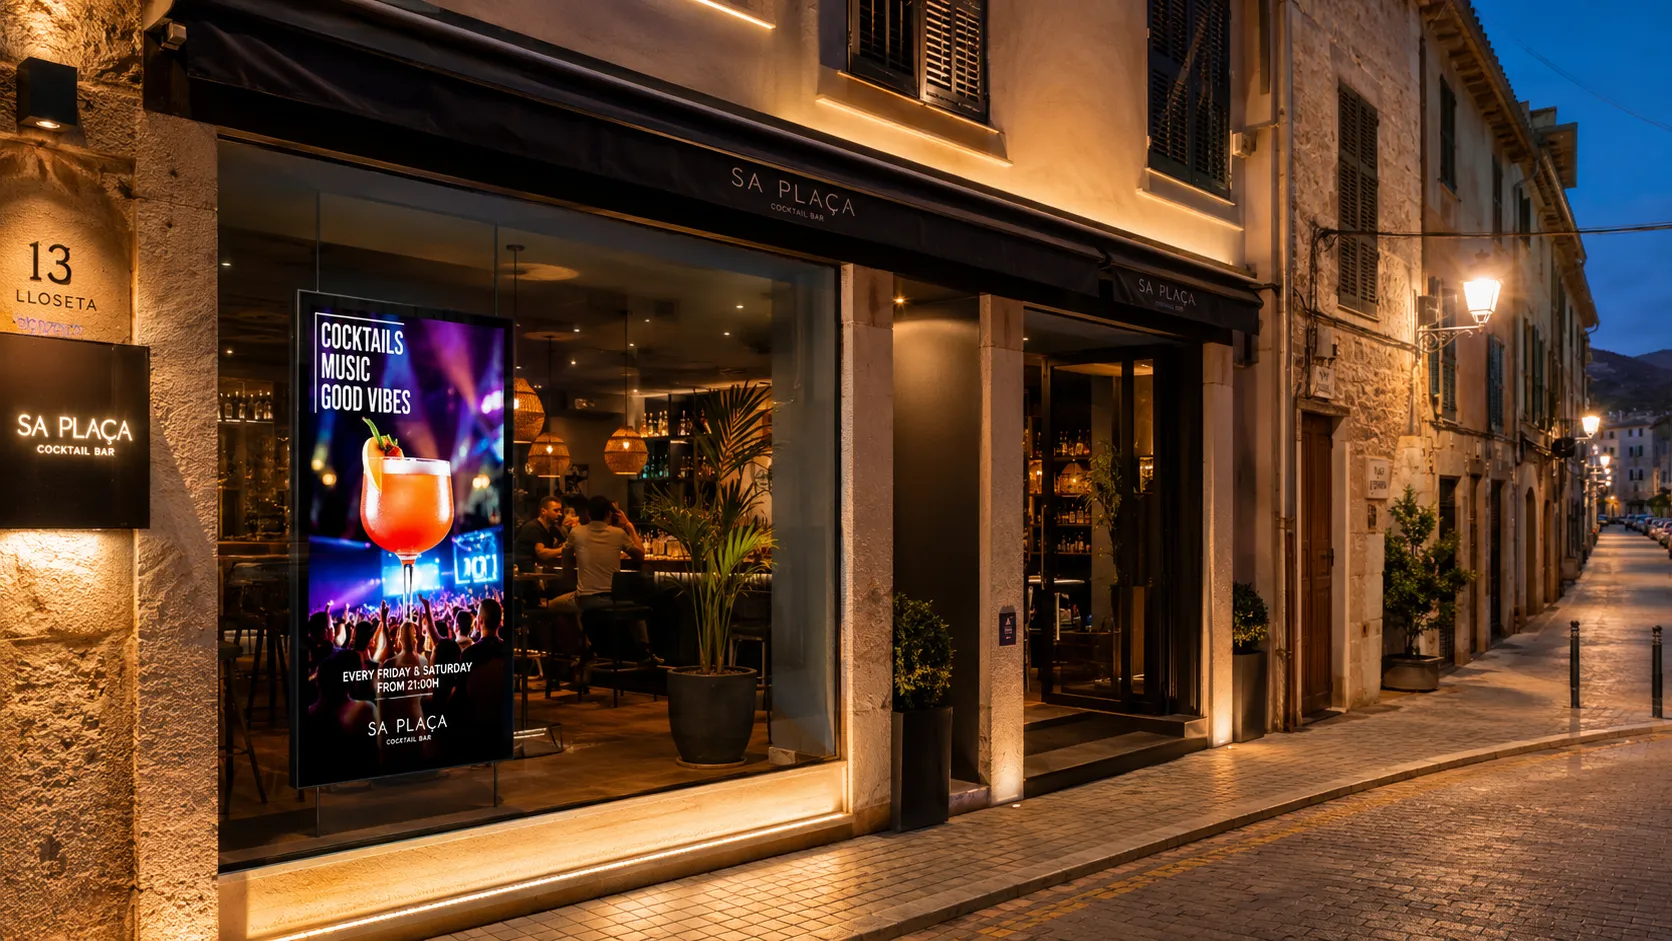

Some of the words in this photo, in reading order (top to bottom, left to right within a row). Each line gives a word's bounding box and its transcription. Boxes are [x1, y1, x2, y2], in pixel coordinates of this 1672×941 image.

[732, 167, 763, 193] SA
[779, 179, 856, 217] PLAÇA
[770, 202, 808, 218] COCKTAIL
[809, 212, 825, 222] BAR
[29, 240, 72, 285] 13
[16, 289, 97, 311] LLOSETA
[1138, 278, 1154, 296] SA
[1159, 284, 1196, 307] PLAÇA
[321, 321, 404, 355] COCKTAILS
[321, 352, 371, 382] MUSIC
[321, 383, 363, 411] GOOD
[367, 387, 411, 415] VIBES
[17, 414, 49, 437] SA
[59, 416, 133, 445] PLAÇA
[37, 444, 90, 456] COCKTAIL
[93, 446, 116, 457] BAR
[343, 669, 375, 682] EVERY
[377, 667, 411, 680] FRIDAY
[413, 665, 420, 676] &
[423, 661, 473, 676] SATURDAY
[377, 680, 405, 694] FROM
[407, 677, 440, 691] 21:00H
[368, 720, 388, 737] SA
[396, 714, 448, 733] PLAÇA
[386, 737, 417, 746] COCKTAIL
[418, 734, 432, 742] BAR
